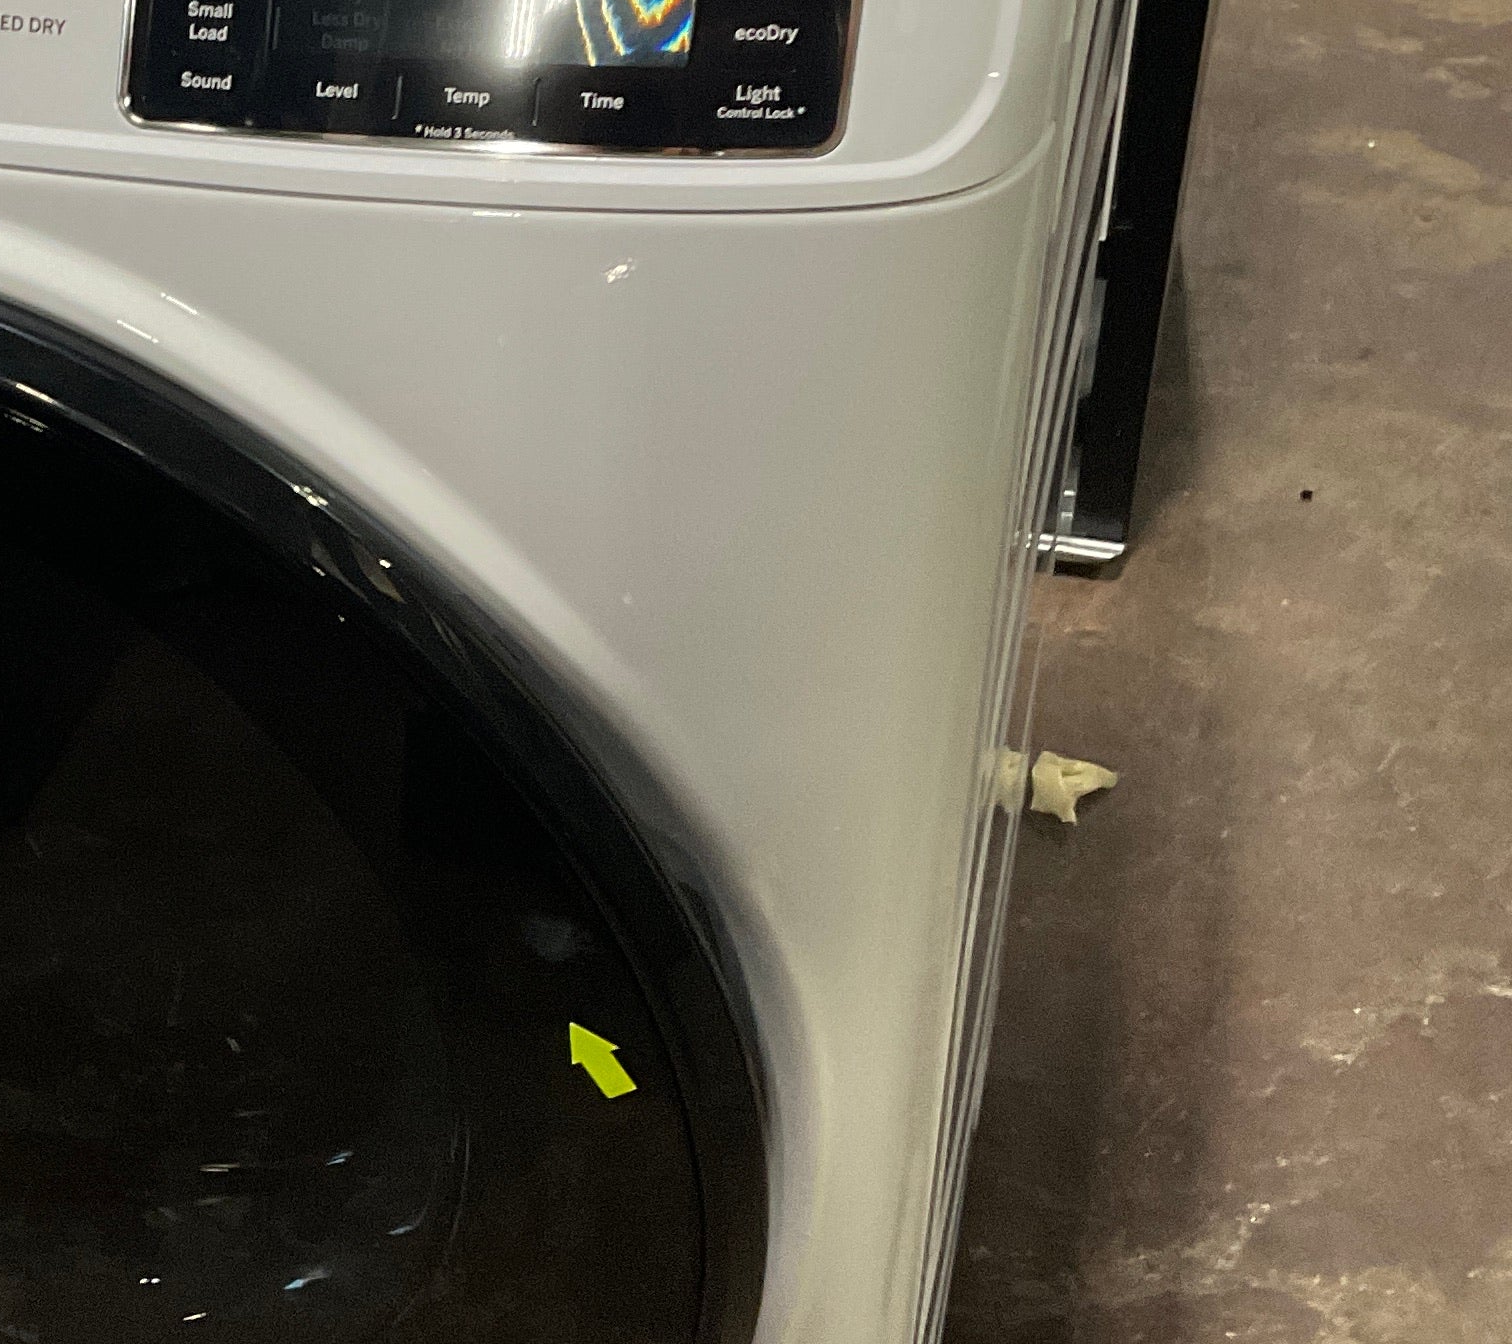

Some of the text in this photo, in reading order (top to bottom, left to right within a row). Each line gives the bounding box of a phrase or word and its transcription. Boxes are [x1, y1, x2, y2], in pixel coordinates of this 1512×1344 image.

[187, 0, 235, 19] Small
[29, 17, 67, 36] DRY
[188, 23, 229, 42] Load
[733, 23, 800, 45] ecoDry
[180, 70, 233, 91] Sound
[315, 80, 360, 99] Level
[444, 86, 491, 108] Temp
[580, 91, 625, 111] Time
[735, 84, 782, 105] Light
[716, 106, 796, 119] Control Lock
